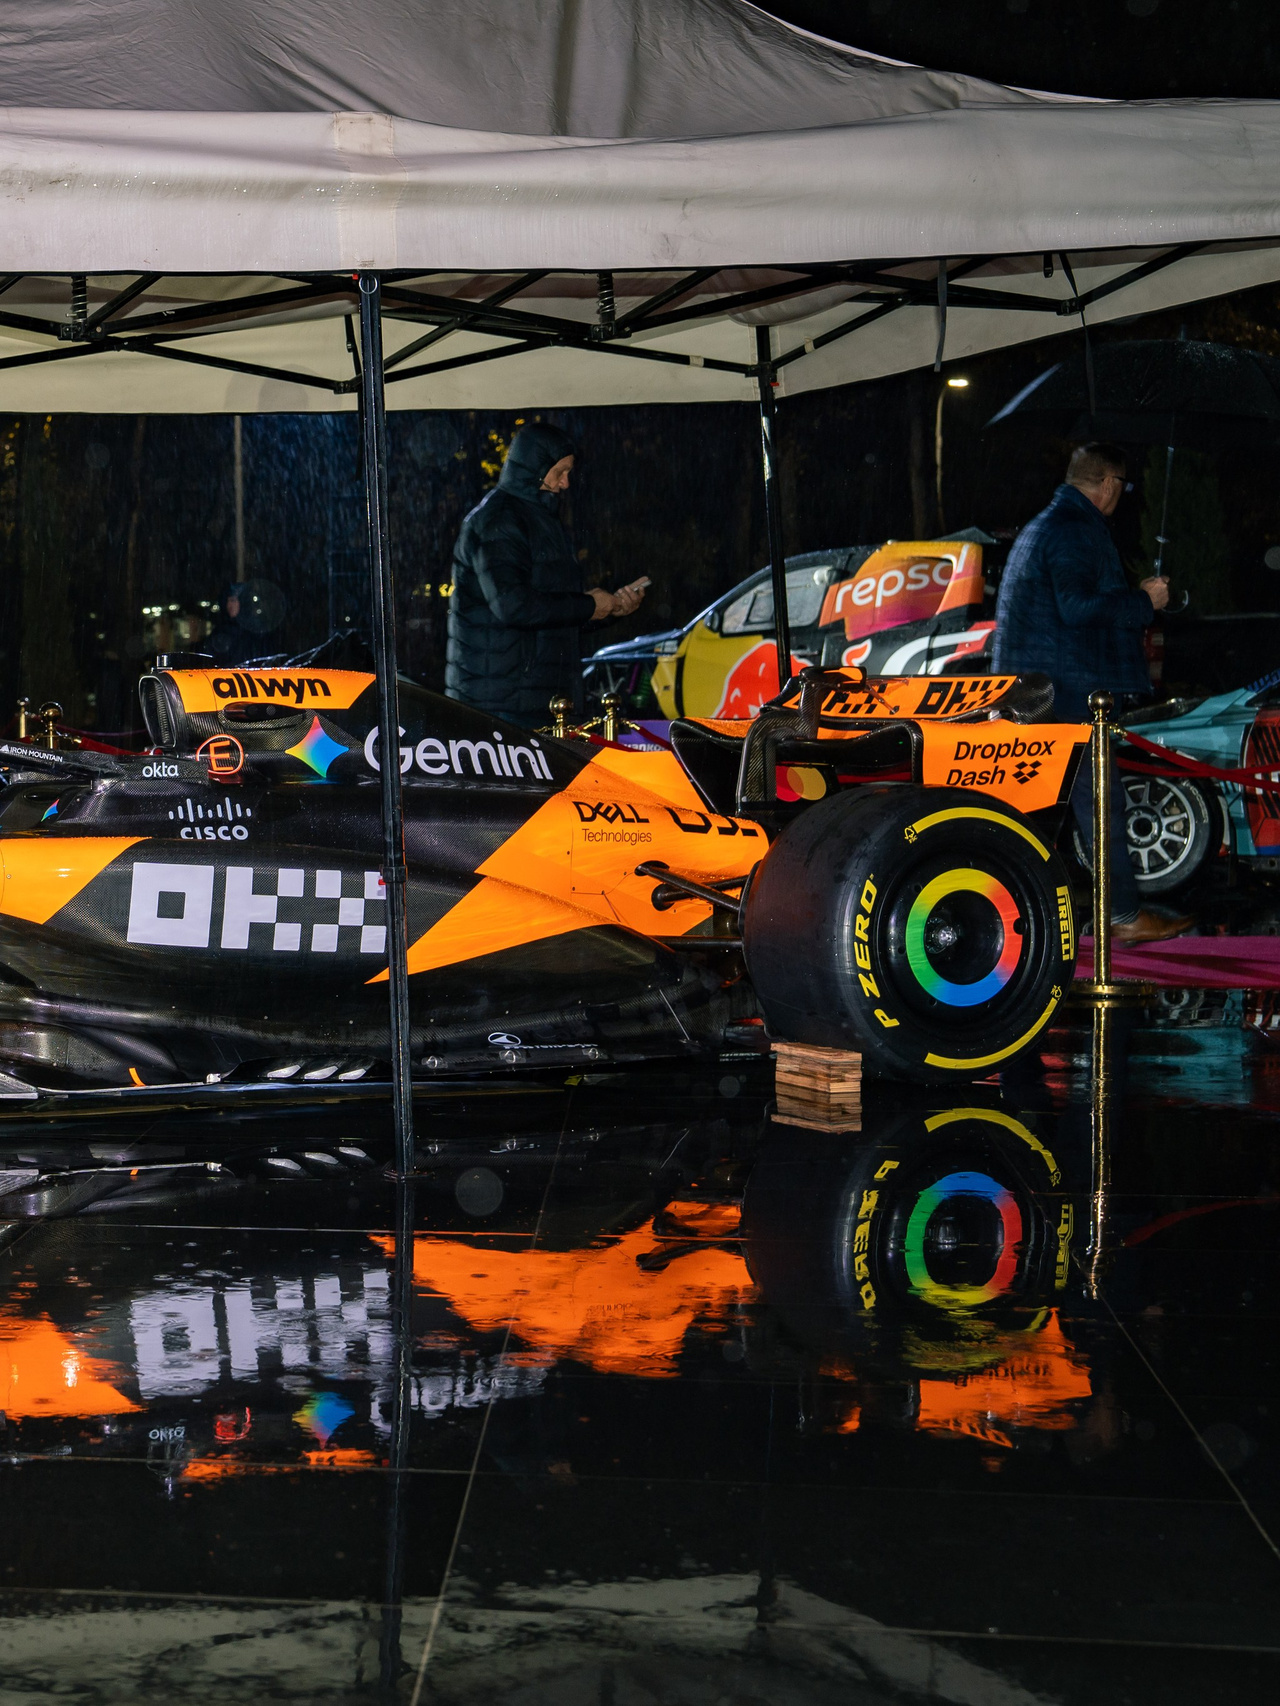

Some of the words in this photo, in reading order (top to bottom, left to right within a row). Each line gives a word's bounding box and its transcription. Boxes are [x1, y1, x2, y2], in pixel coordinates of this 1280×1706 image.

[835, 544, 970, 613] repsol
[212, 672, 332, 704] allwyn
[10, 746, 28, 756] IRON
[28, 750, 63, 763] MOUNTAIN
[209, 740, 234, 771] E
[364, 725, 554, 780] Gemini
[953, 738, 1057, 763] Dropbox
[142, 762, 179, 778] okta
[946, 765, 1006, 786] Dash
[572, 801, 650, 824] DELL
[581, 828, 652, 846] Technologies
[1056, 885, 1074, 961] PIRELLI
[854, 879, 881, 999] ZERO
[873, 1008, 900, 1028] P
